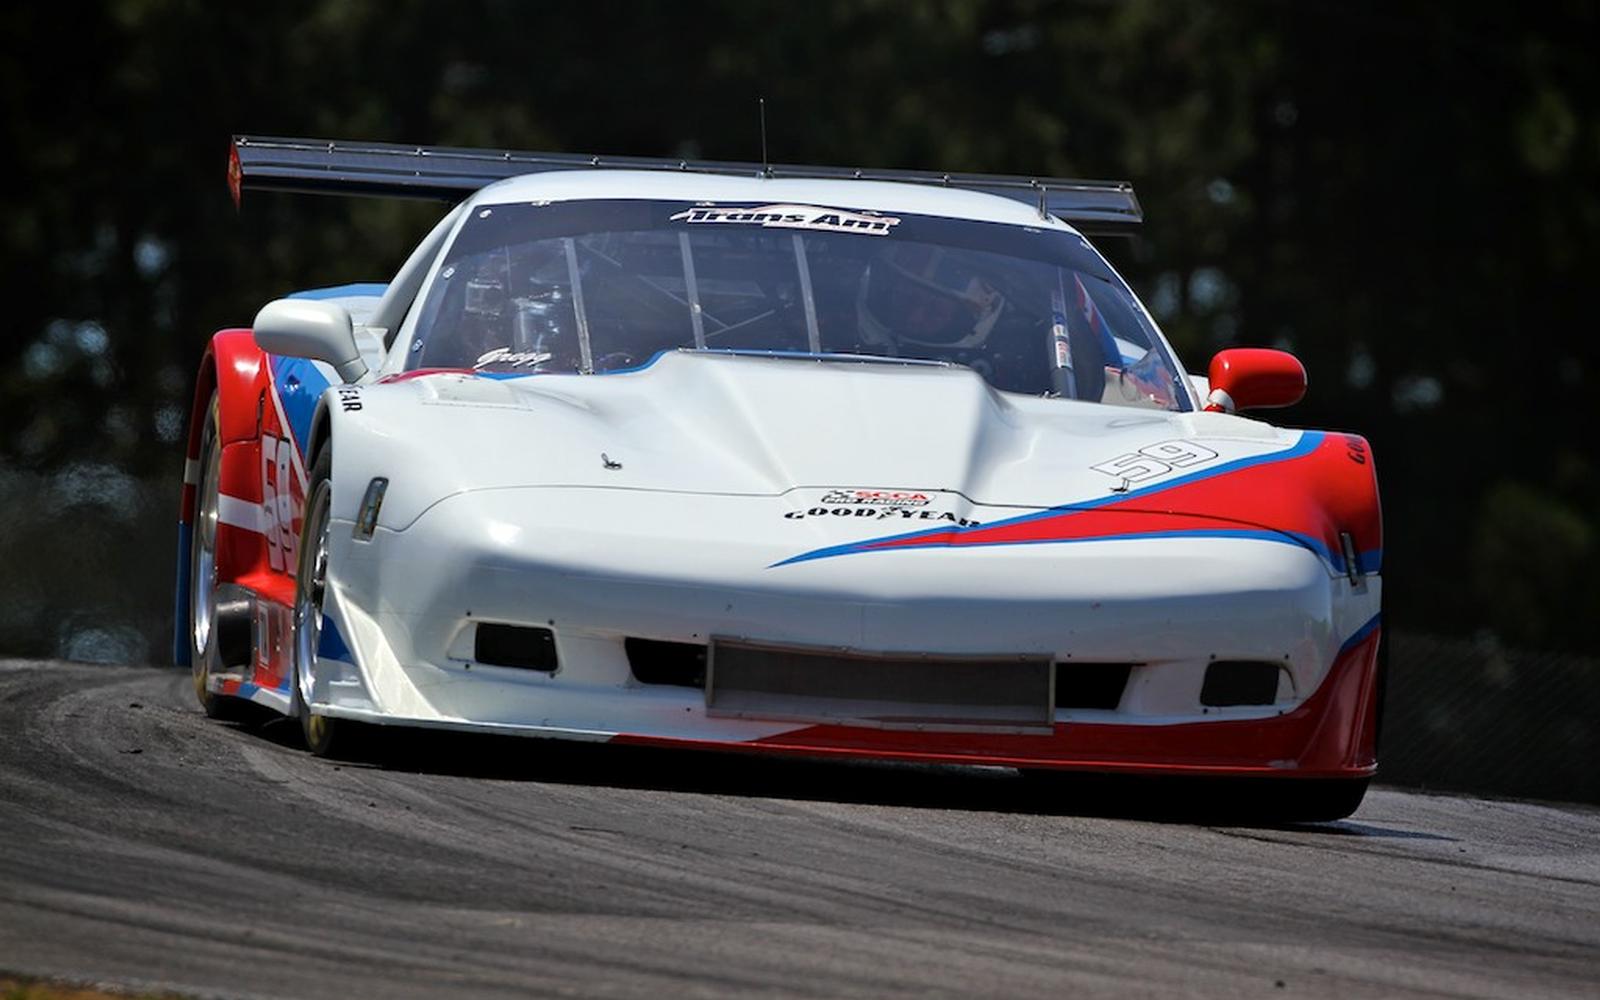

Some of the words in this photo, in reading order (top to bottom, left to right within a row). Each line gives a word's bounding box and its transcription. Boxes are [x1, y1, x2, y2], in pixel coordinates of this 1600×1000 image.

[687, 207, 806, 225] Trans
[811, 213, 889, 232] Am
[1089, 438, 1219, 483] 59
